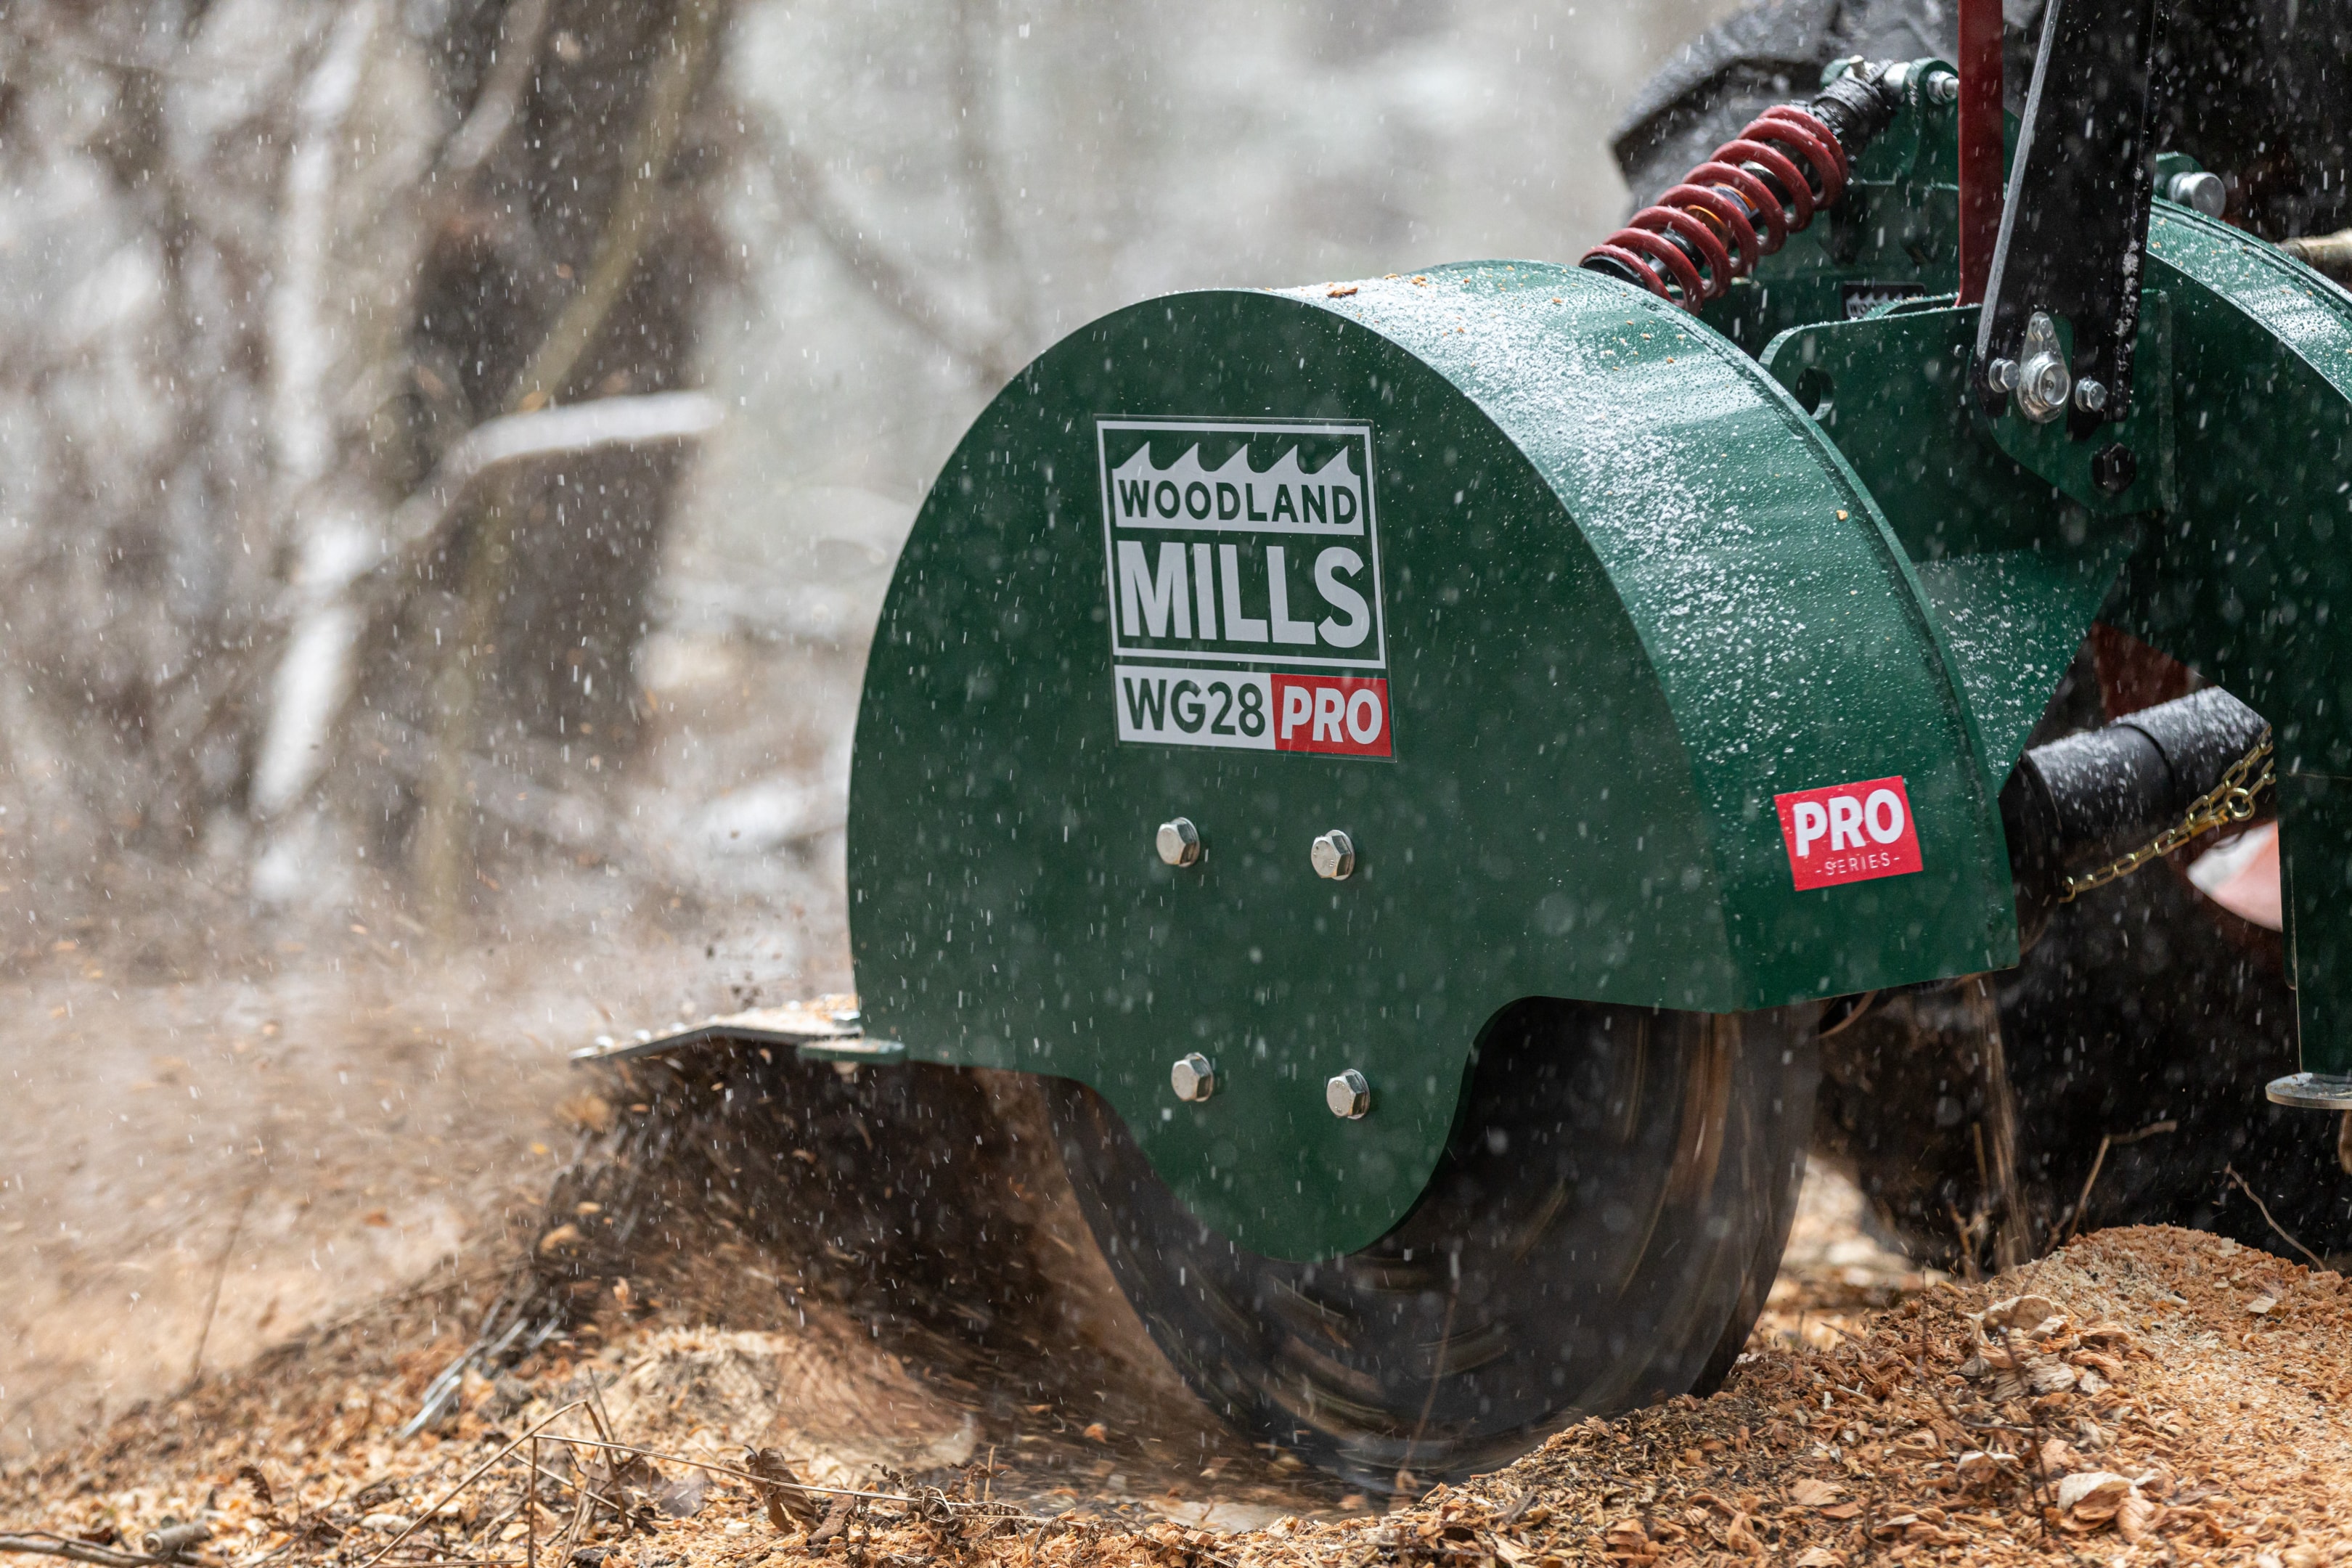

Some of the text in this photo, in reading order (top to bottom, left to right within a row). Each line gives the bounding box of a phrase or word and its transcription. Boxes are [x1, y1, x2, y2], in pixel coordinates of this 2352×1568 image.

[1118, 479, 1357, 524] WOODLAND
[1117, 540, 1371, 648] MILLS
[1123, 677, 1383, 745] WG28 PRO
[1792, 788, 1905, 857] PRO
